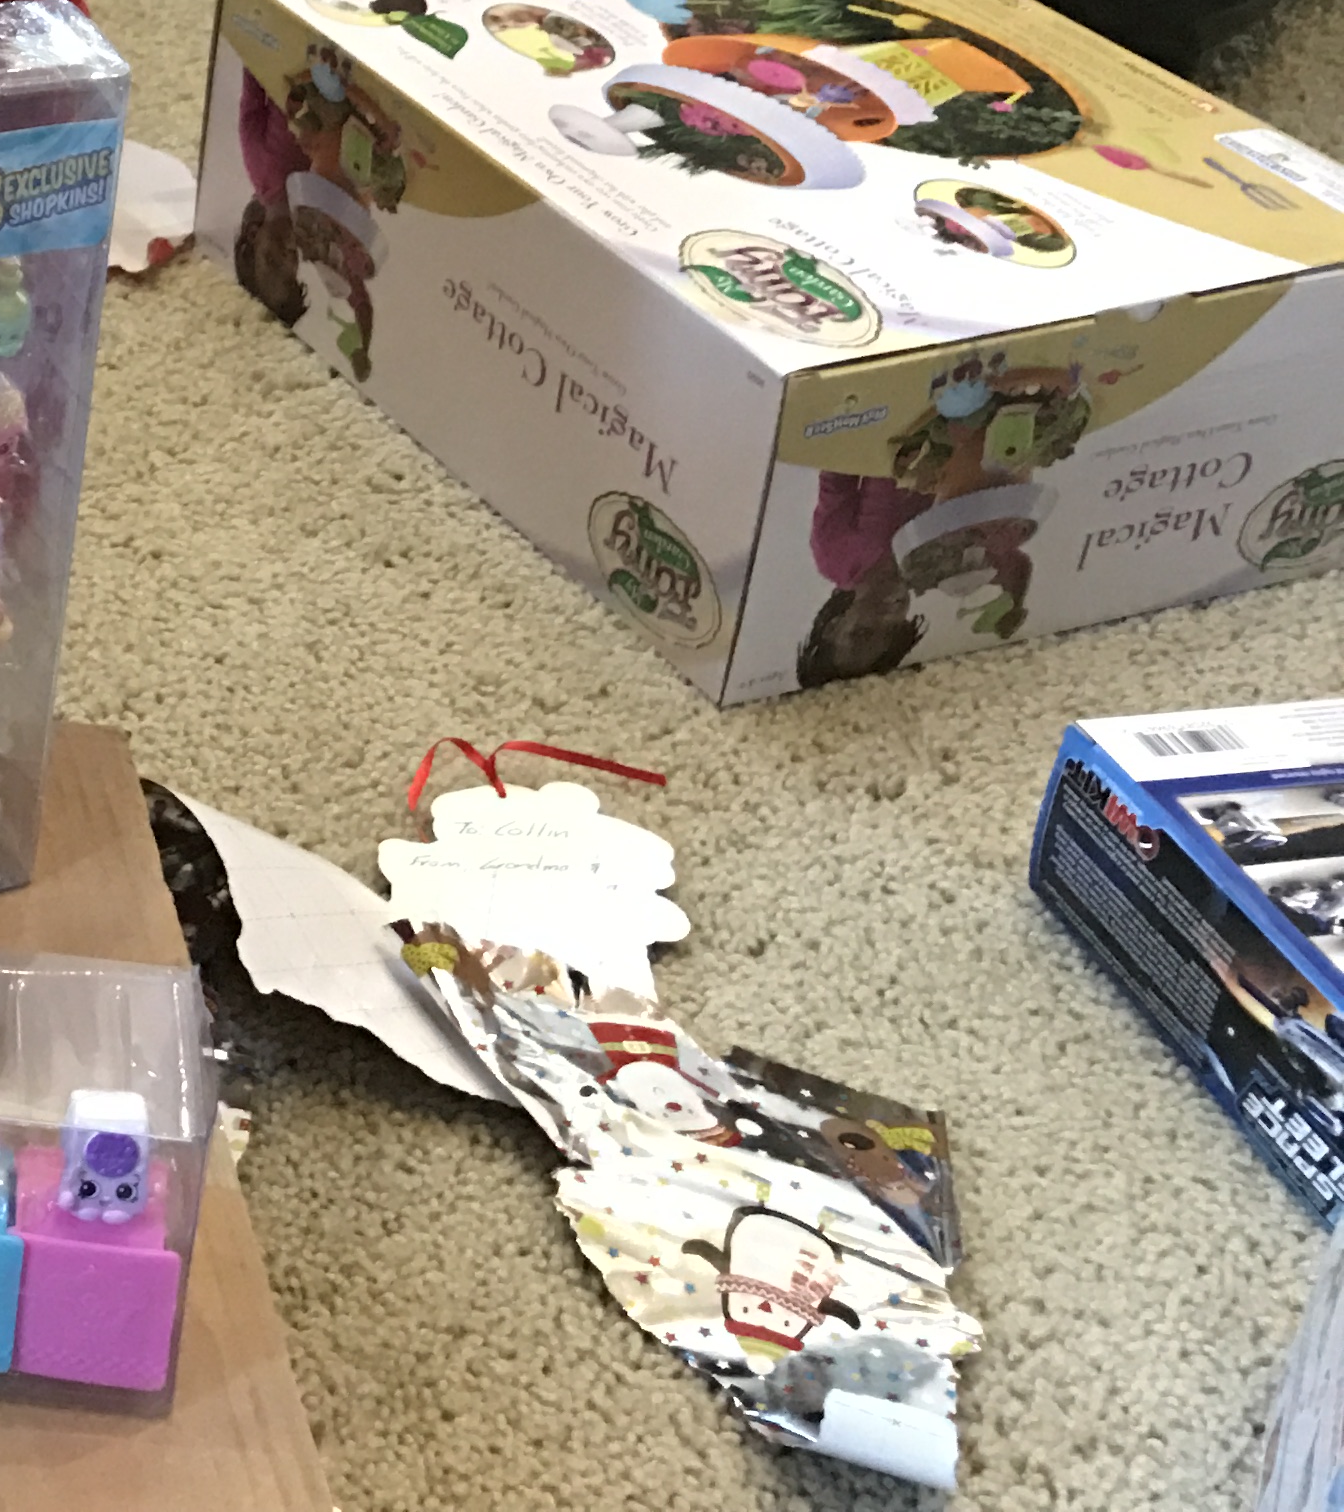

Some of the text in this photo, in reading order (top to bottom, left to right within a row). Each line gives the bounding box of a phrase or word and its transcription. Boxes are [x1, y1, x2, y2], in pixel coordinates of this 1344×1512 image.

[3, 150, 110, 200] EXCLUSIVE
[8, 187, 105, 226] SHOPKINS!
[442, 277, 679, 496] Magical Cottage
[1103, 451, 1253, 502] Cottage
[1076, 502, 1234, 572] Magical
